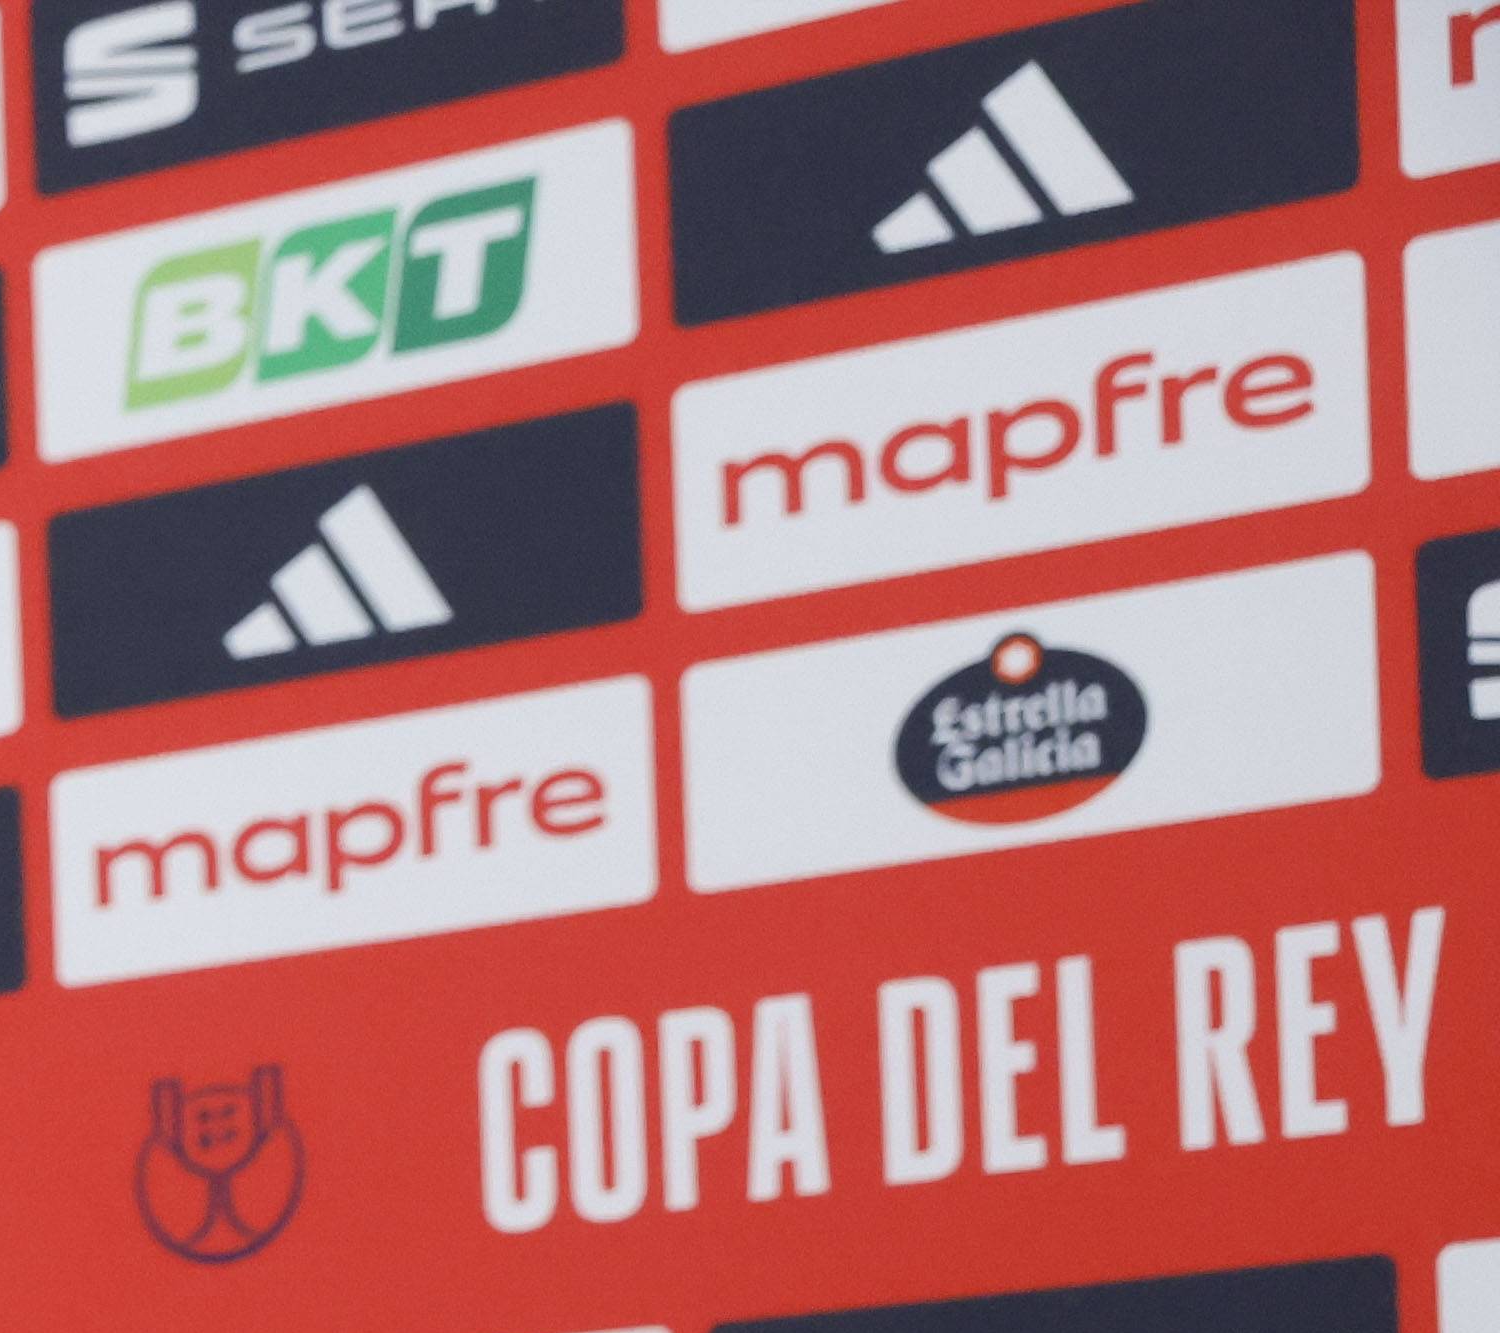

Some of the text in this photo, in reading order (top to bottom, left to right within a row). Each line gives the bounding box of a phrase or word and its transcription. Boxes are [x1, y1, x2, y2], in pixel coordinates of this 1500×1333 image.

[128, 182, 530, 402] BKT
[721, 352, 1316, 525] mapfre
[931, 680, 1108, 746] Estrella
[937, 726, 1100, 791] Galicia
[95, 762, 606, 909] mapfre
[480, 908, 1444, 1233] COPA DEL REY
